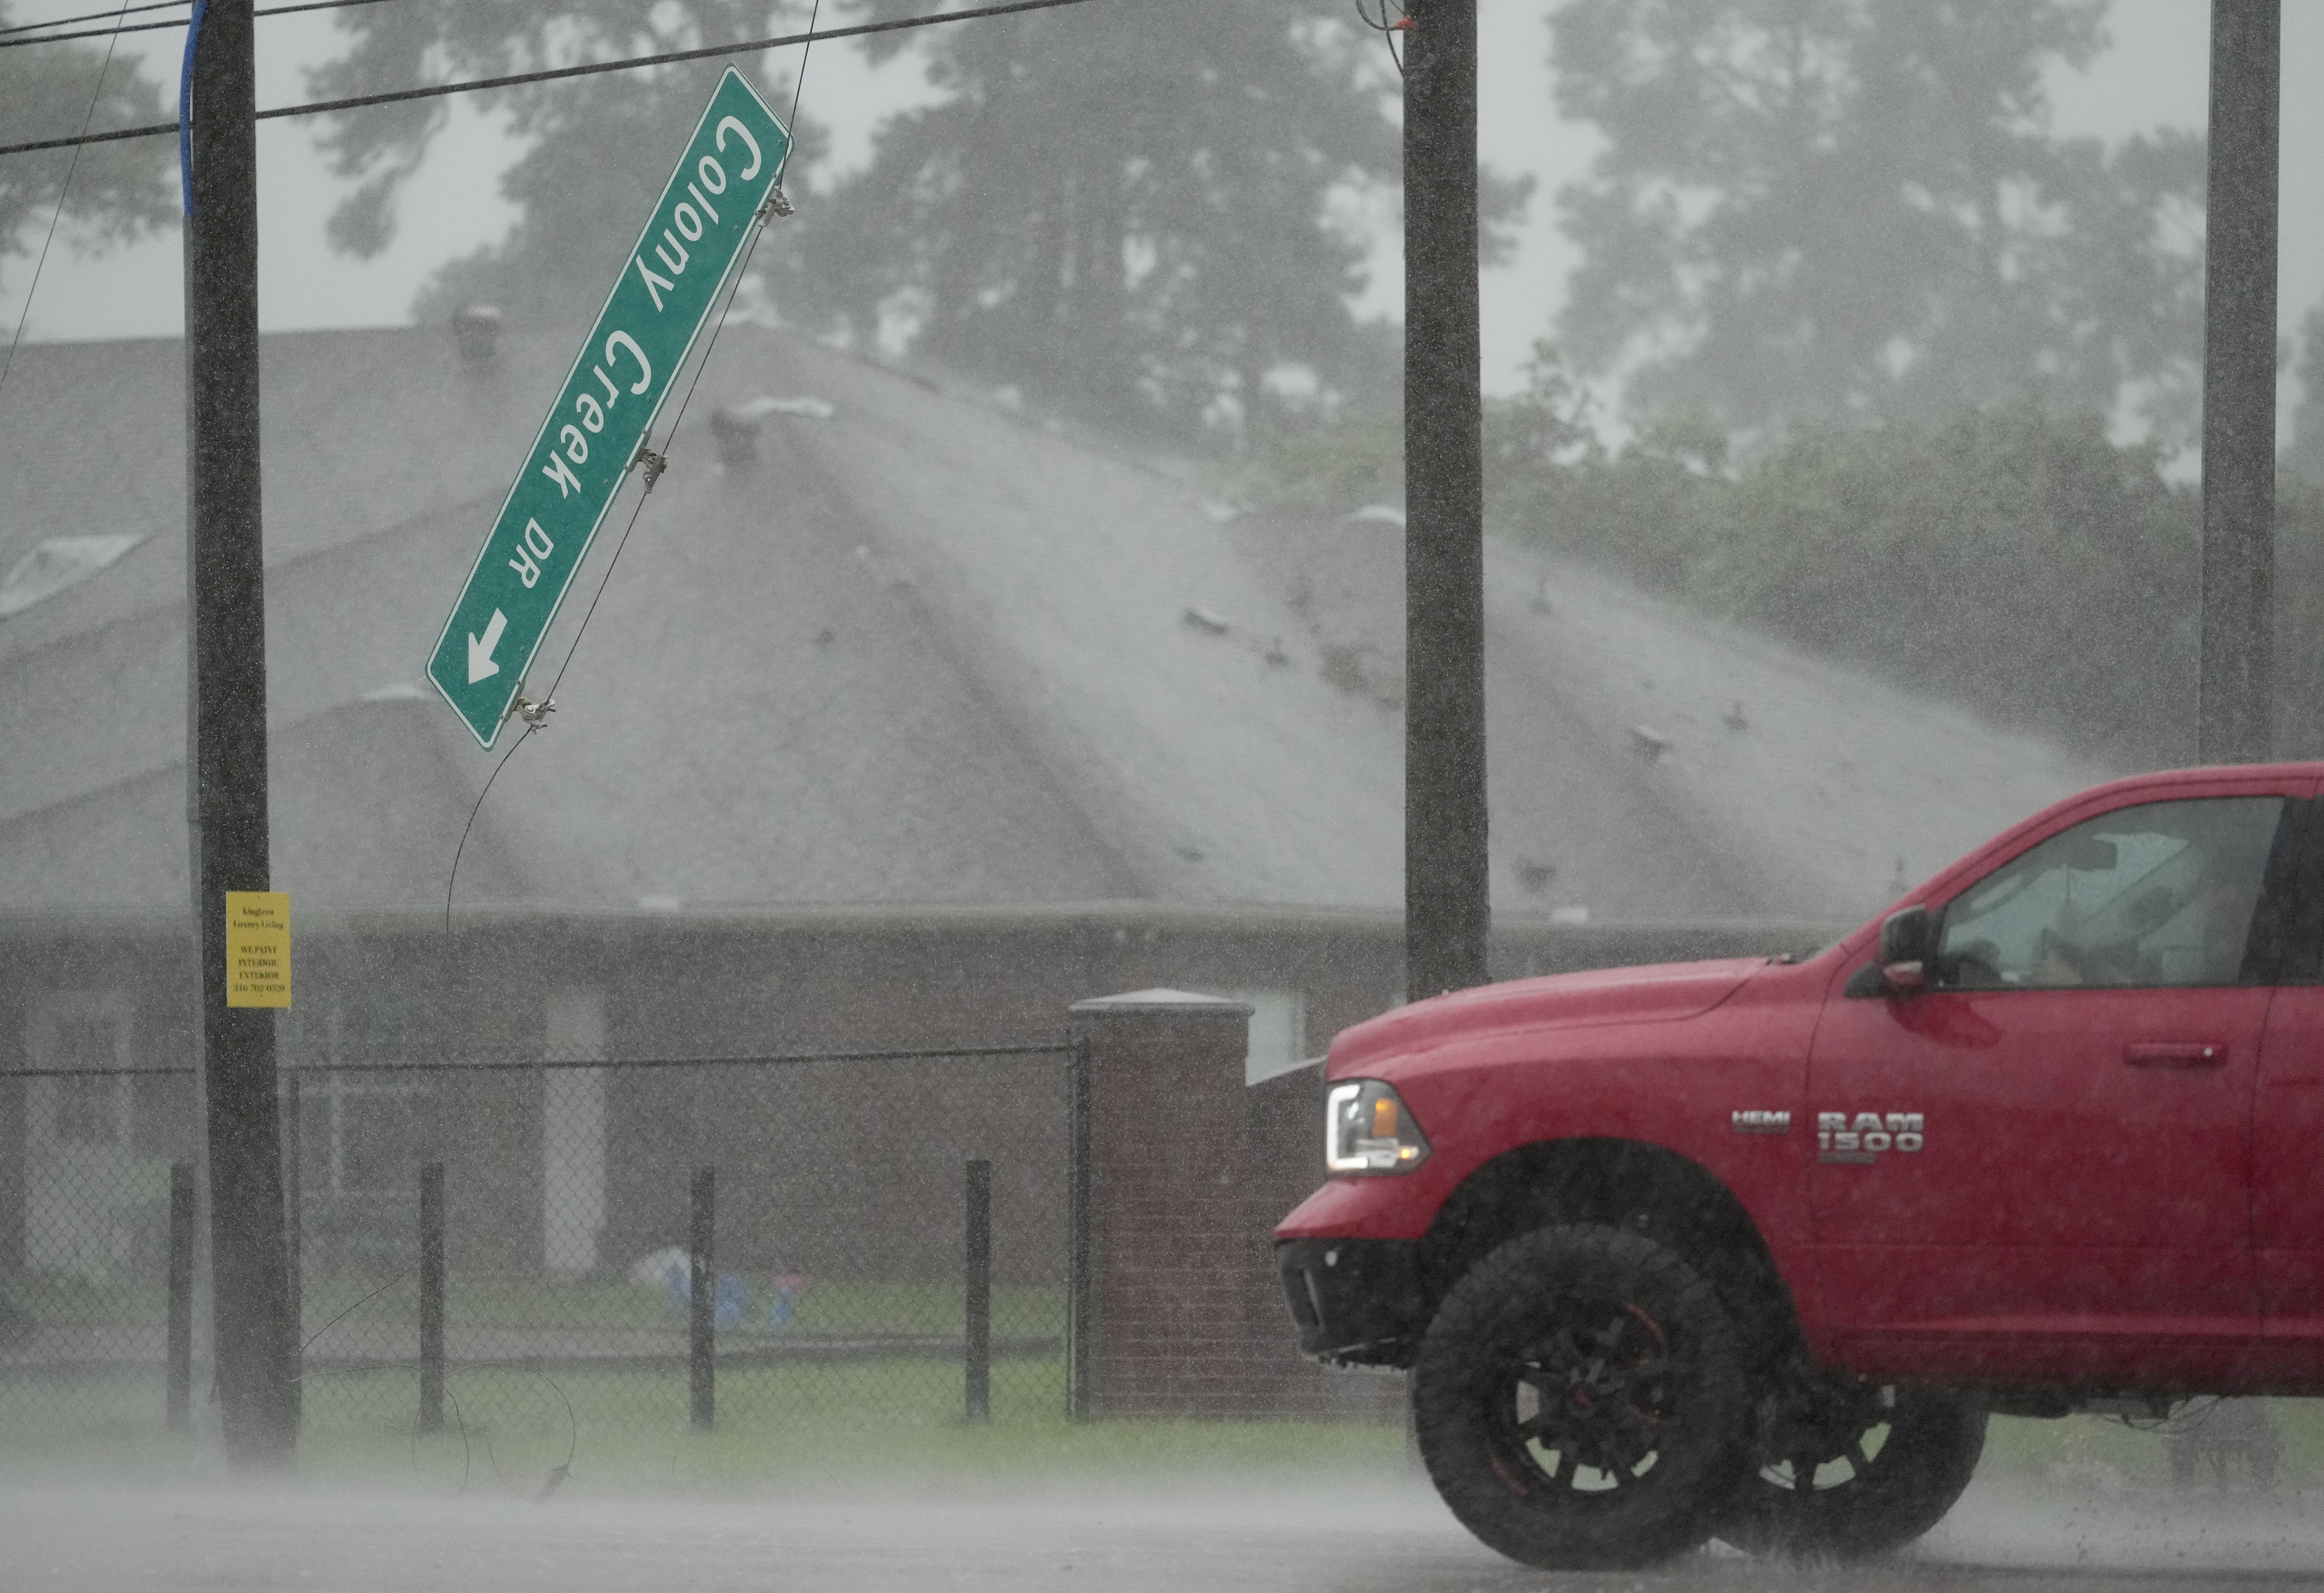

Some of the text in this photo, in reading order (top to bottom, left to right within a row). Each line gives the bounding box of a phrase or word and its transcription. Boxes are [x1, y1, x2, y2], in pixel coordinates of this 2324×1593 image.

[508, 115, 761, 589] Colony Creek DR
[239, 958, 277, 967] INTERIOR
[239, 972, 280, 980] EXTERIOR
[1731, 1110, 1790, 1123] HEMI
[1817, 1113, 1923, 1131] RAM
[1817, 1132, 1923, 1151] 1500
